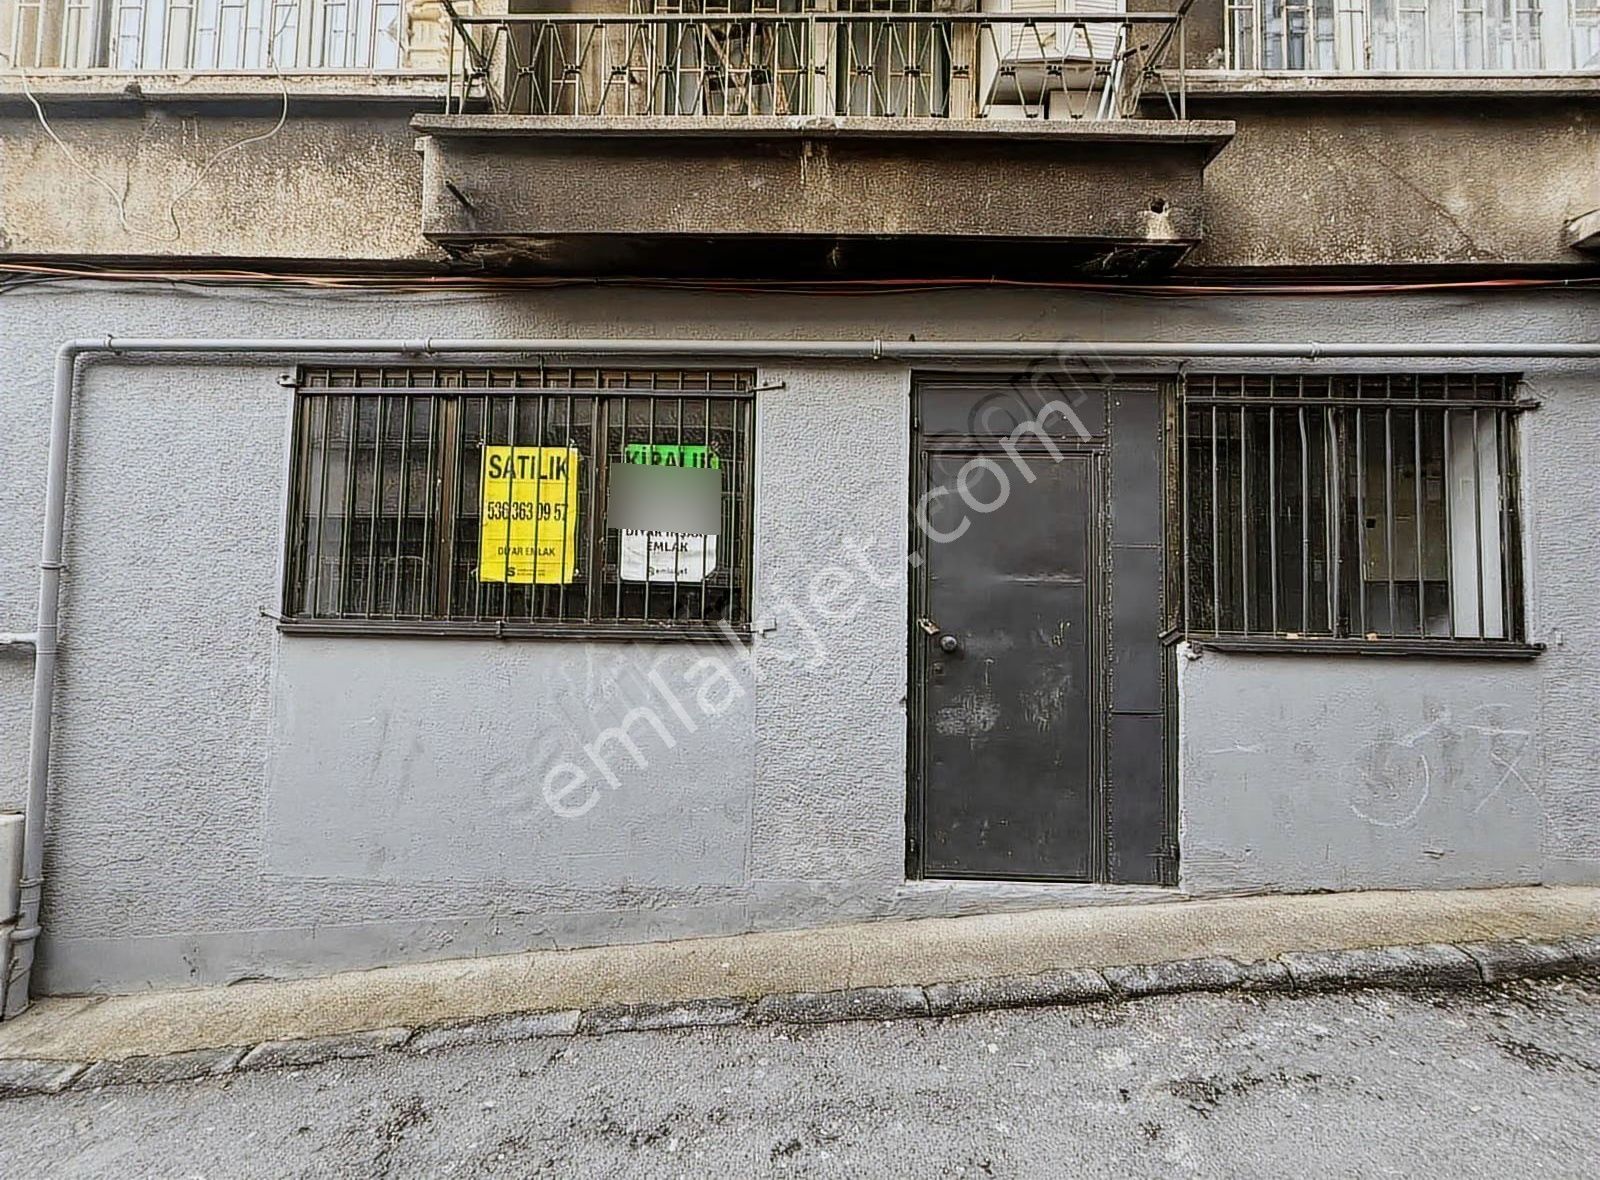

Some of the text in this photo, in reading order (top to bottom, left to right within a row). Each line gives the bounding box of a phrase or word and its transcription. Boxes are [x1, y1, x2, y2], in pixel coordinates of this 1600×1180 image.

[488, 454, 569, 480] SATILIK
[511, 501, 533, 520] 363
[647, 541, 689, 552] EMLAK
